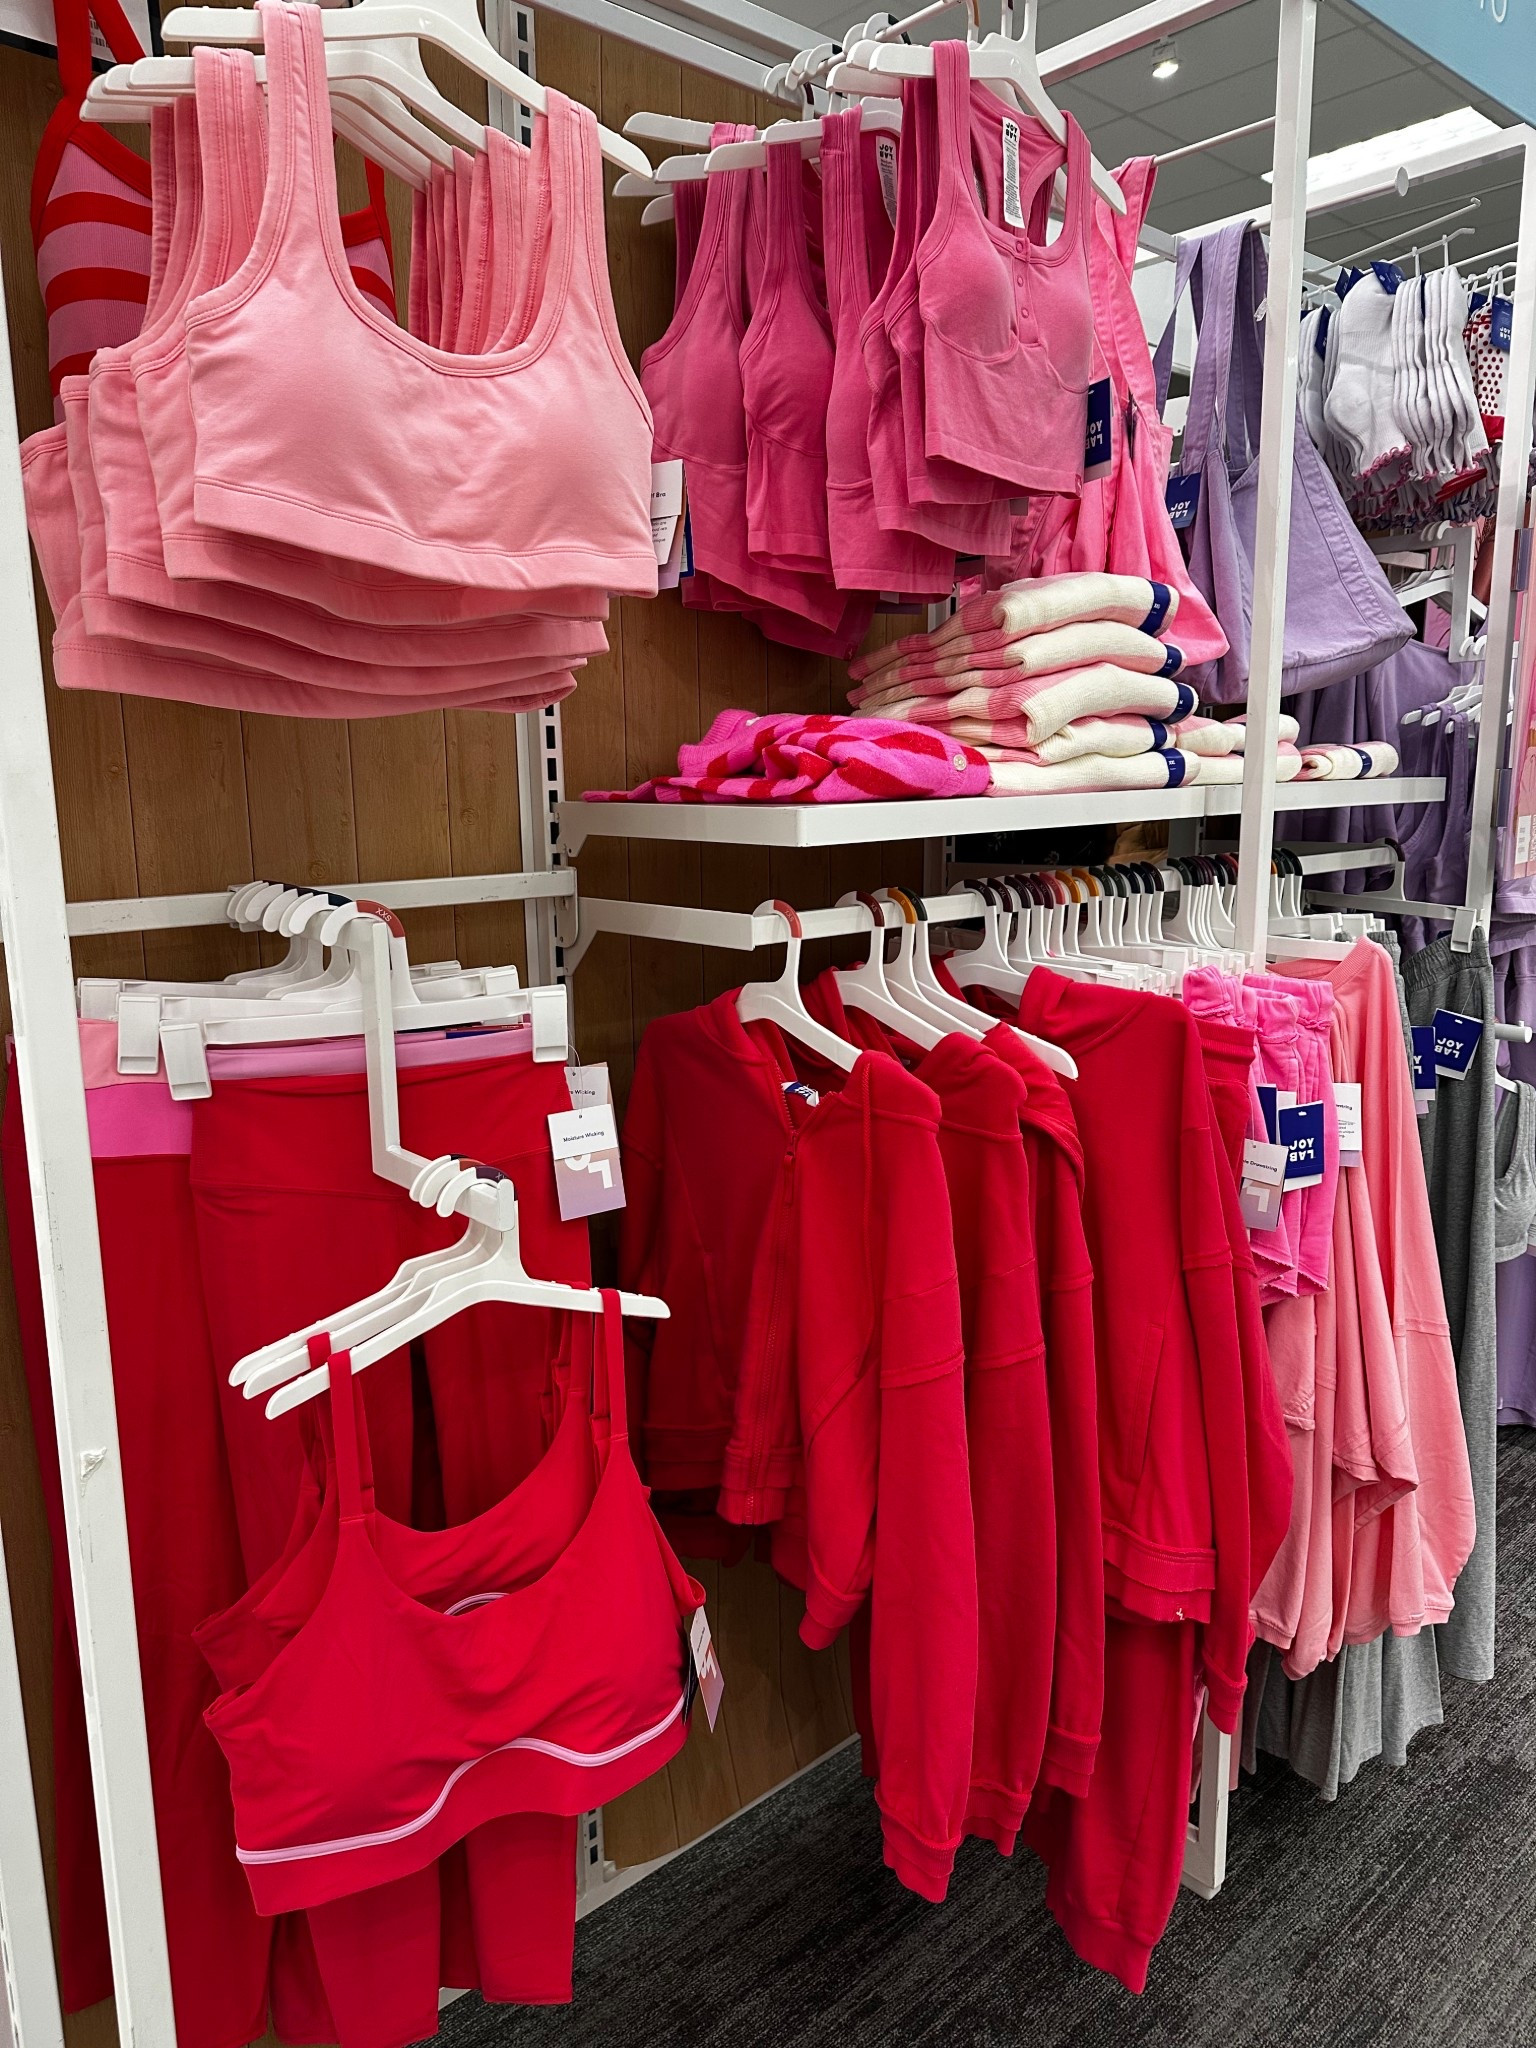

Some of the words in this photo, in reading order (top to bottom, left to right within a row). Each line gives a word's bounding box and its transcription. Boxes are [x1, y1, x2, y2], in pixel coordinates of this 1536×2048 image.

[879, 144, 893, 153] JOY
[1170, 500, 1191, 511] JOY
[375, 907, 392, 922] XXS
[1437, 1037, 1464, 1050] JOY
[1434, 1045, 1460, 1059] LAB
[563, 1134, 585, 1143] Moisture
[584, 1130, 605, 1138] Wicking
[1289, 1137, 1315, 1151] JOY
[1289, 1149, 1315, 1162] LAB
[1250, 1160, 1278, 1172] Drawstring
